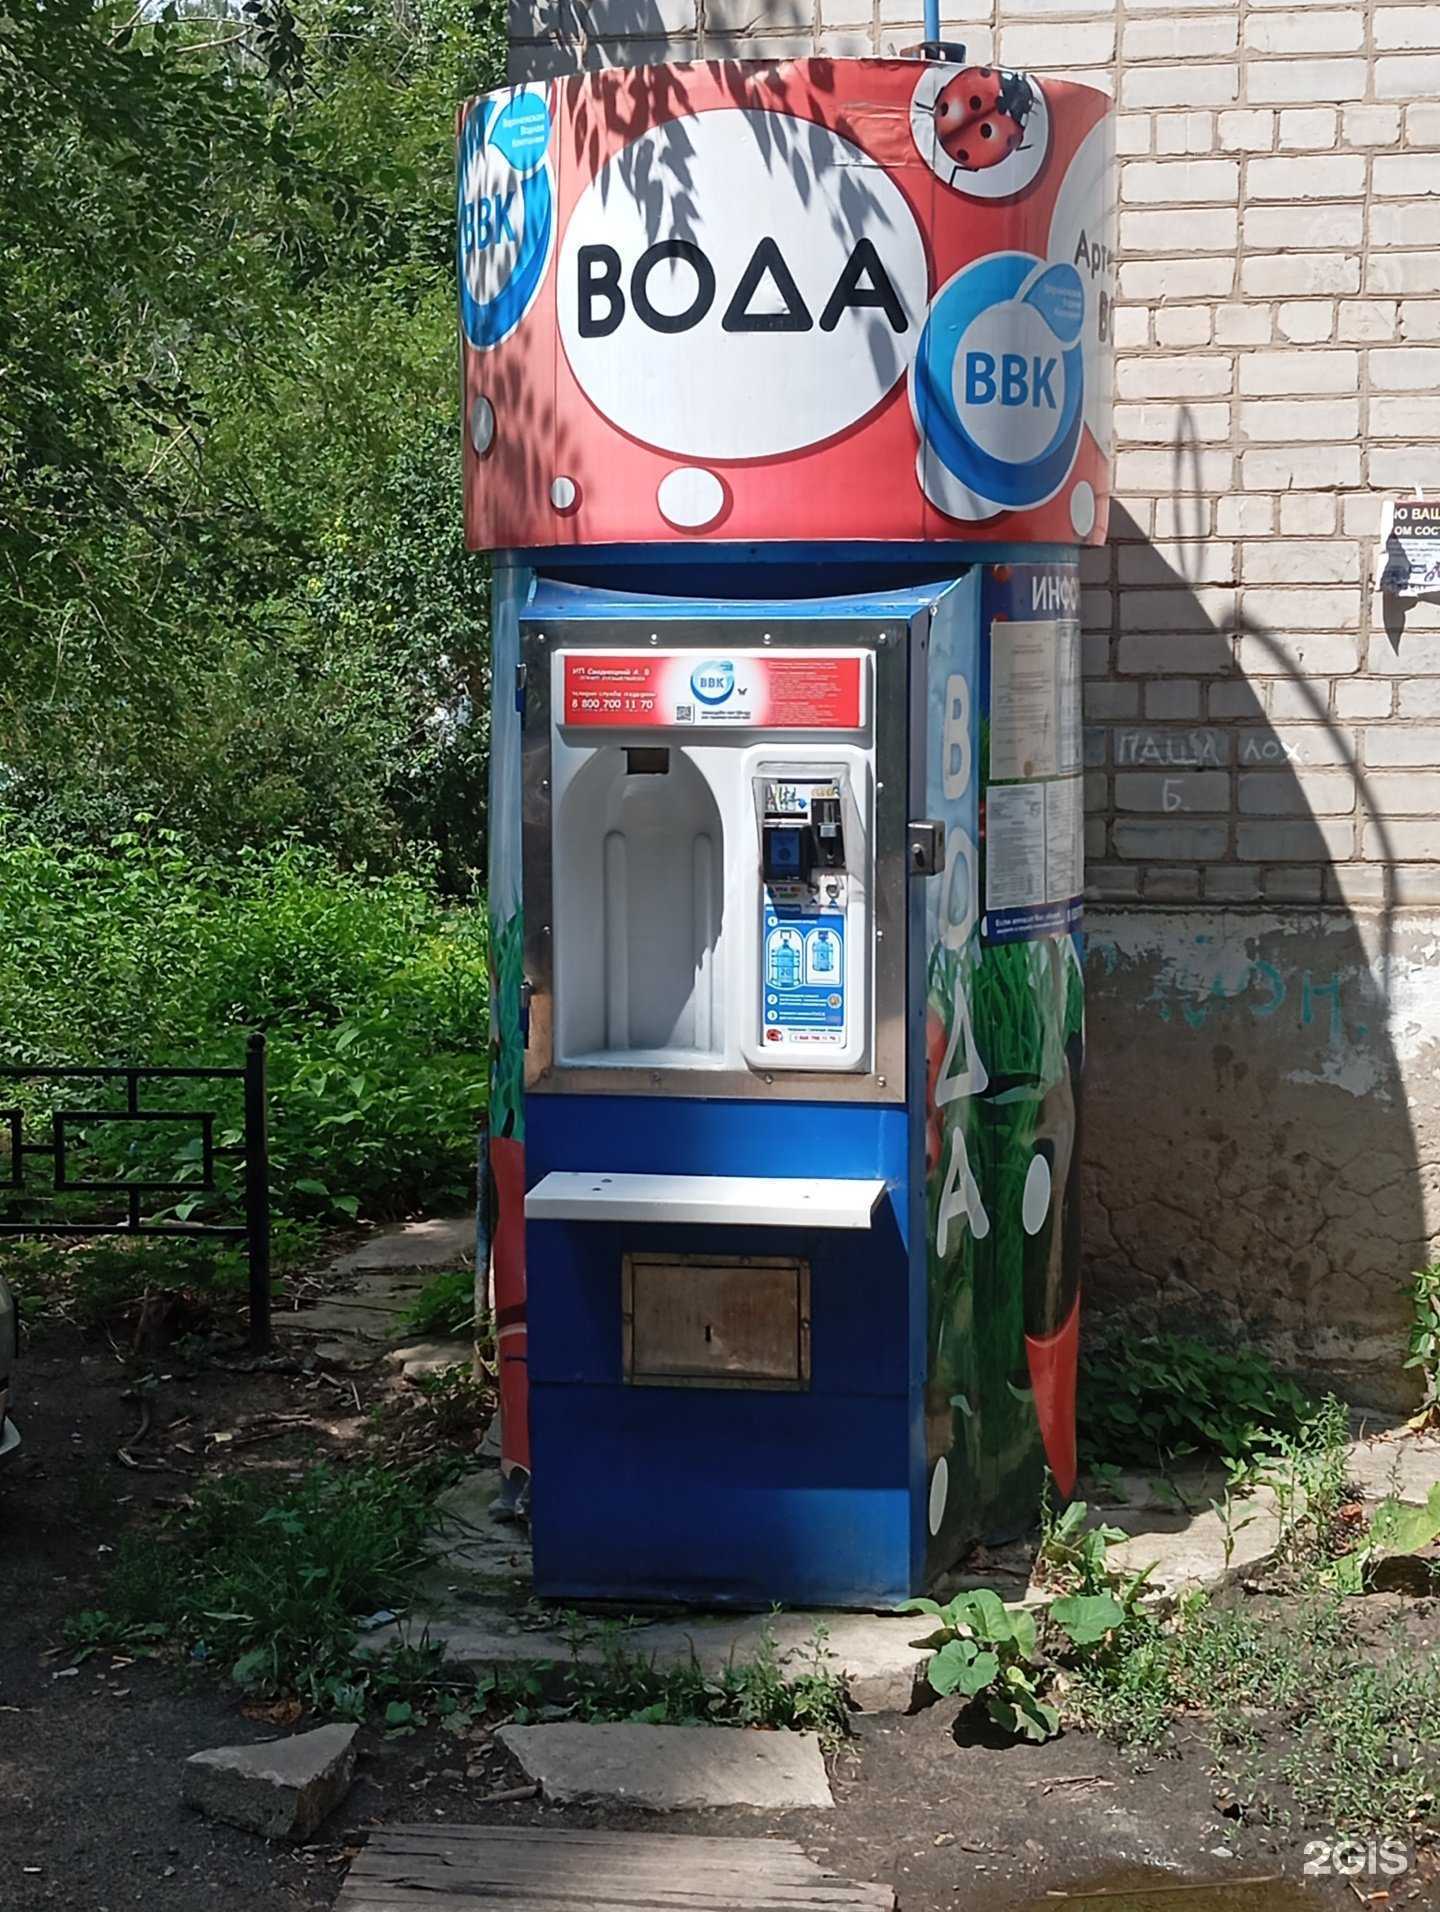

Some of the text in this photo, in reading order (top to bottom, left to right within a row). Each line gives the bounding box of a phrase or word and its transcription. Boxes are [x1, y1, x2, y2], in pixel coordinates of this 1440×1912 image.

[577, 236, 909, 338] ВОДА
[965, 352, 1057, 409] ВВК
[1414, 525, 1440, 536] СОС
[700, 677, 725, 688] ВВК
[582, 699, 600, 709] 800
[603, 699, 622, 709] 700
[625, 699, 636, 709] 11
[640, 699, 654, 709] 70
